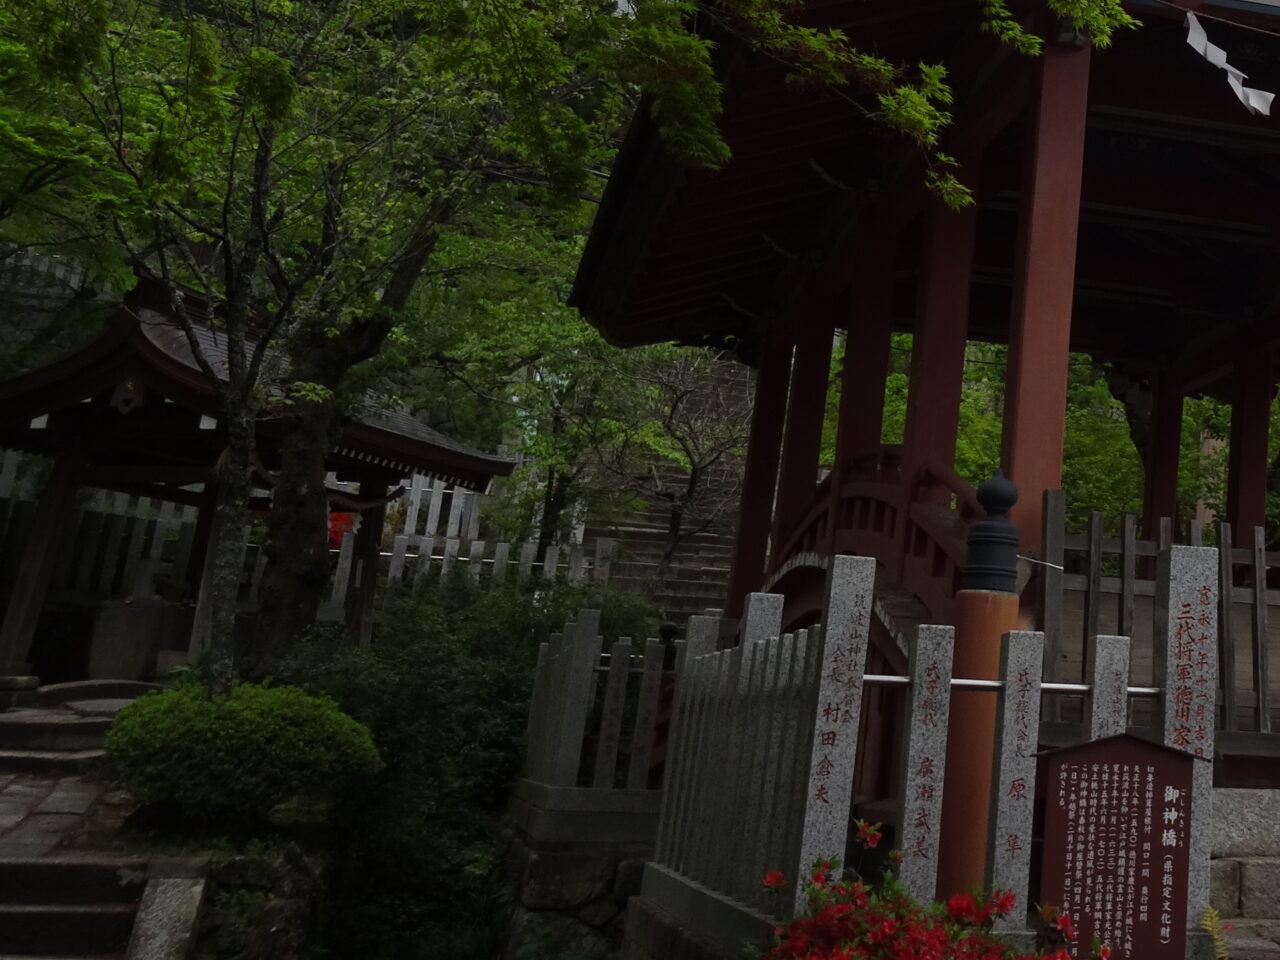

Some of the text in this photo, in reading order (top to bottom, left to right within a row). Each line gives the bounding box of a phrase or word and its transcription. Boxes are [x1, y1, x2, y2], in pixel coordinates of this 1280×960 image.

[1173, 603, 1196, 749] 三代将軍徳川家
[1178, 788, 1187, 848] ごしんきょう
